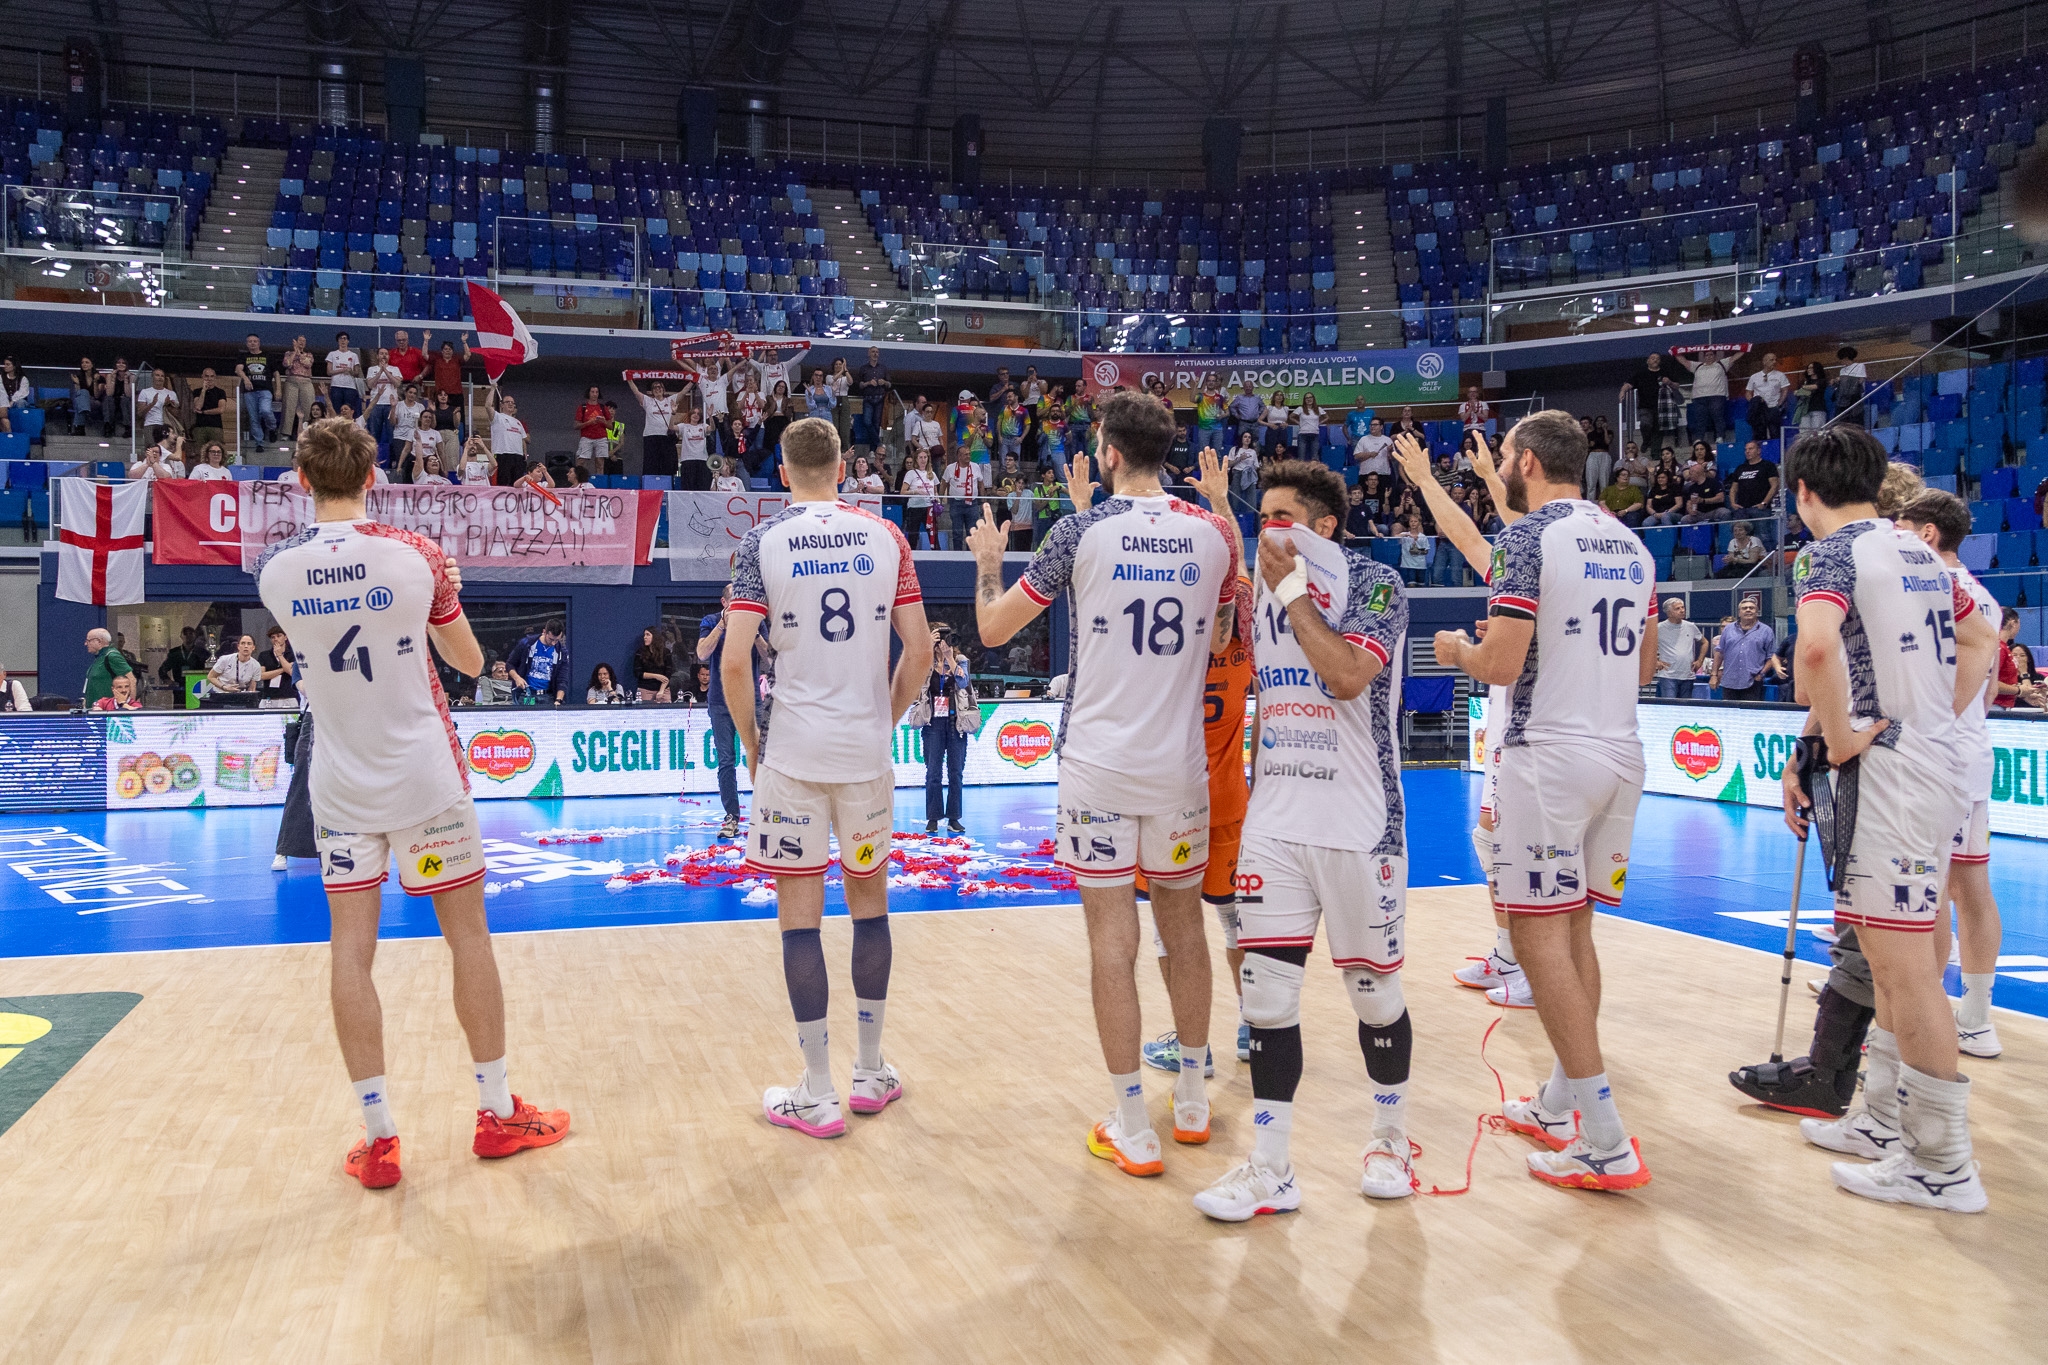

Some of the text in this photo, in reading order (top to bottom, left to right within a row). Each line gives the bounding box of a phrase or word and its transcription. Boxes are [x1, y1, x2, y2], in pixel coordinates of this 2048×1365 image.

[680, 335, 719, 347] MILANO
[1228, 366, 1395, 389] ARCOBALENO
[252, 481, 292, 505] PER
[404, 488, 478, 518] NOSTRO
[788, 532, 868, 552] MASULOVIC'
[1122, 536, 1193, 554] CANESCHI
[1898, 549, 1936, 565] OTSUKA
[307, 564, 366, 586] ICHINO
[792, 560, 849, 578] Allianz
[1112, 564, 1175, 582] Allianz
[1584, 562, 1626, 580] Allianz
[1901, 576, 1939, 592] Allianz
[292, 596, 361, 617] Allianz
[820, 588, 855, 643] 8
[1123, 597, 1184, 656] 18
[1592, 598, 1636, 656] 16
[1925, 608, 1956, 665] 15
[329, 625, 373, 682] 4
[397, 646, 414, 656] errea
[1002, 735, 1051, 747] Del Monte
[1276, 726, 1338, 745] Huwell
[472, 744, 530, 759] Del Monte
[572, 730, 660, 773] SCEGLI
[669, 729, 694, 770] IL
[1276, 742, 1338, 752] chemicals
[1676, 740, 1719, 757] Del Monte
[1264, 759, 1338, 780] DeniCar
[773, 815, 810, 824] GRILLO
[1081, 814, 1120, 824] GRILLO
[760, 833, 803, 860] LS
[1070, 836, 1116, 862] LS
[446, 851, 471, 864] ARGO
[1526, 868, 1579, 898] LS
[1374, 1037, 1392, 1048] N1
